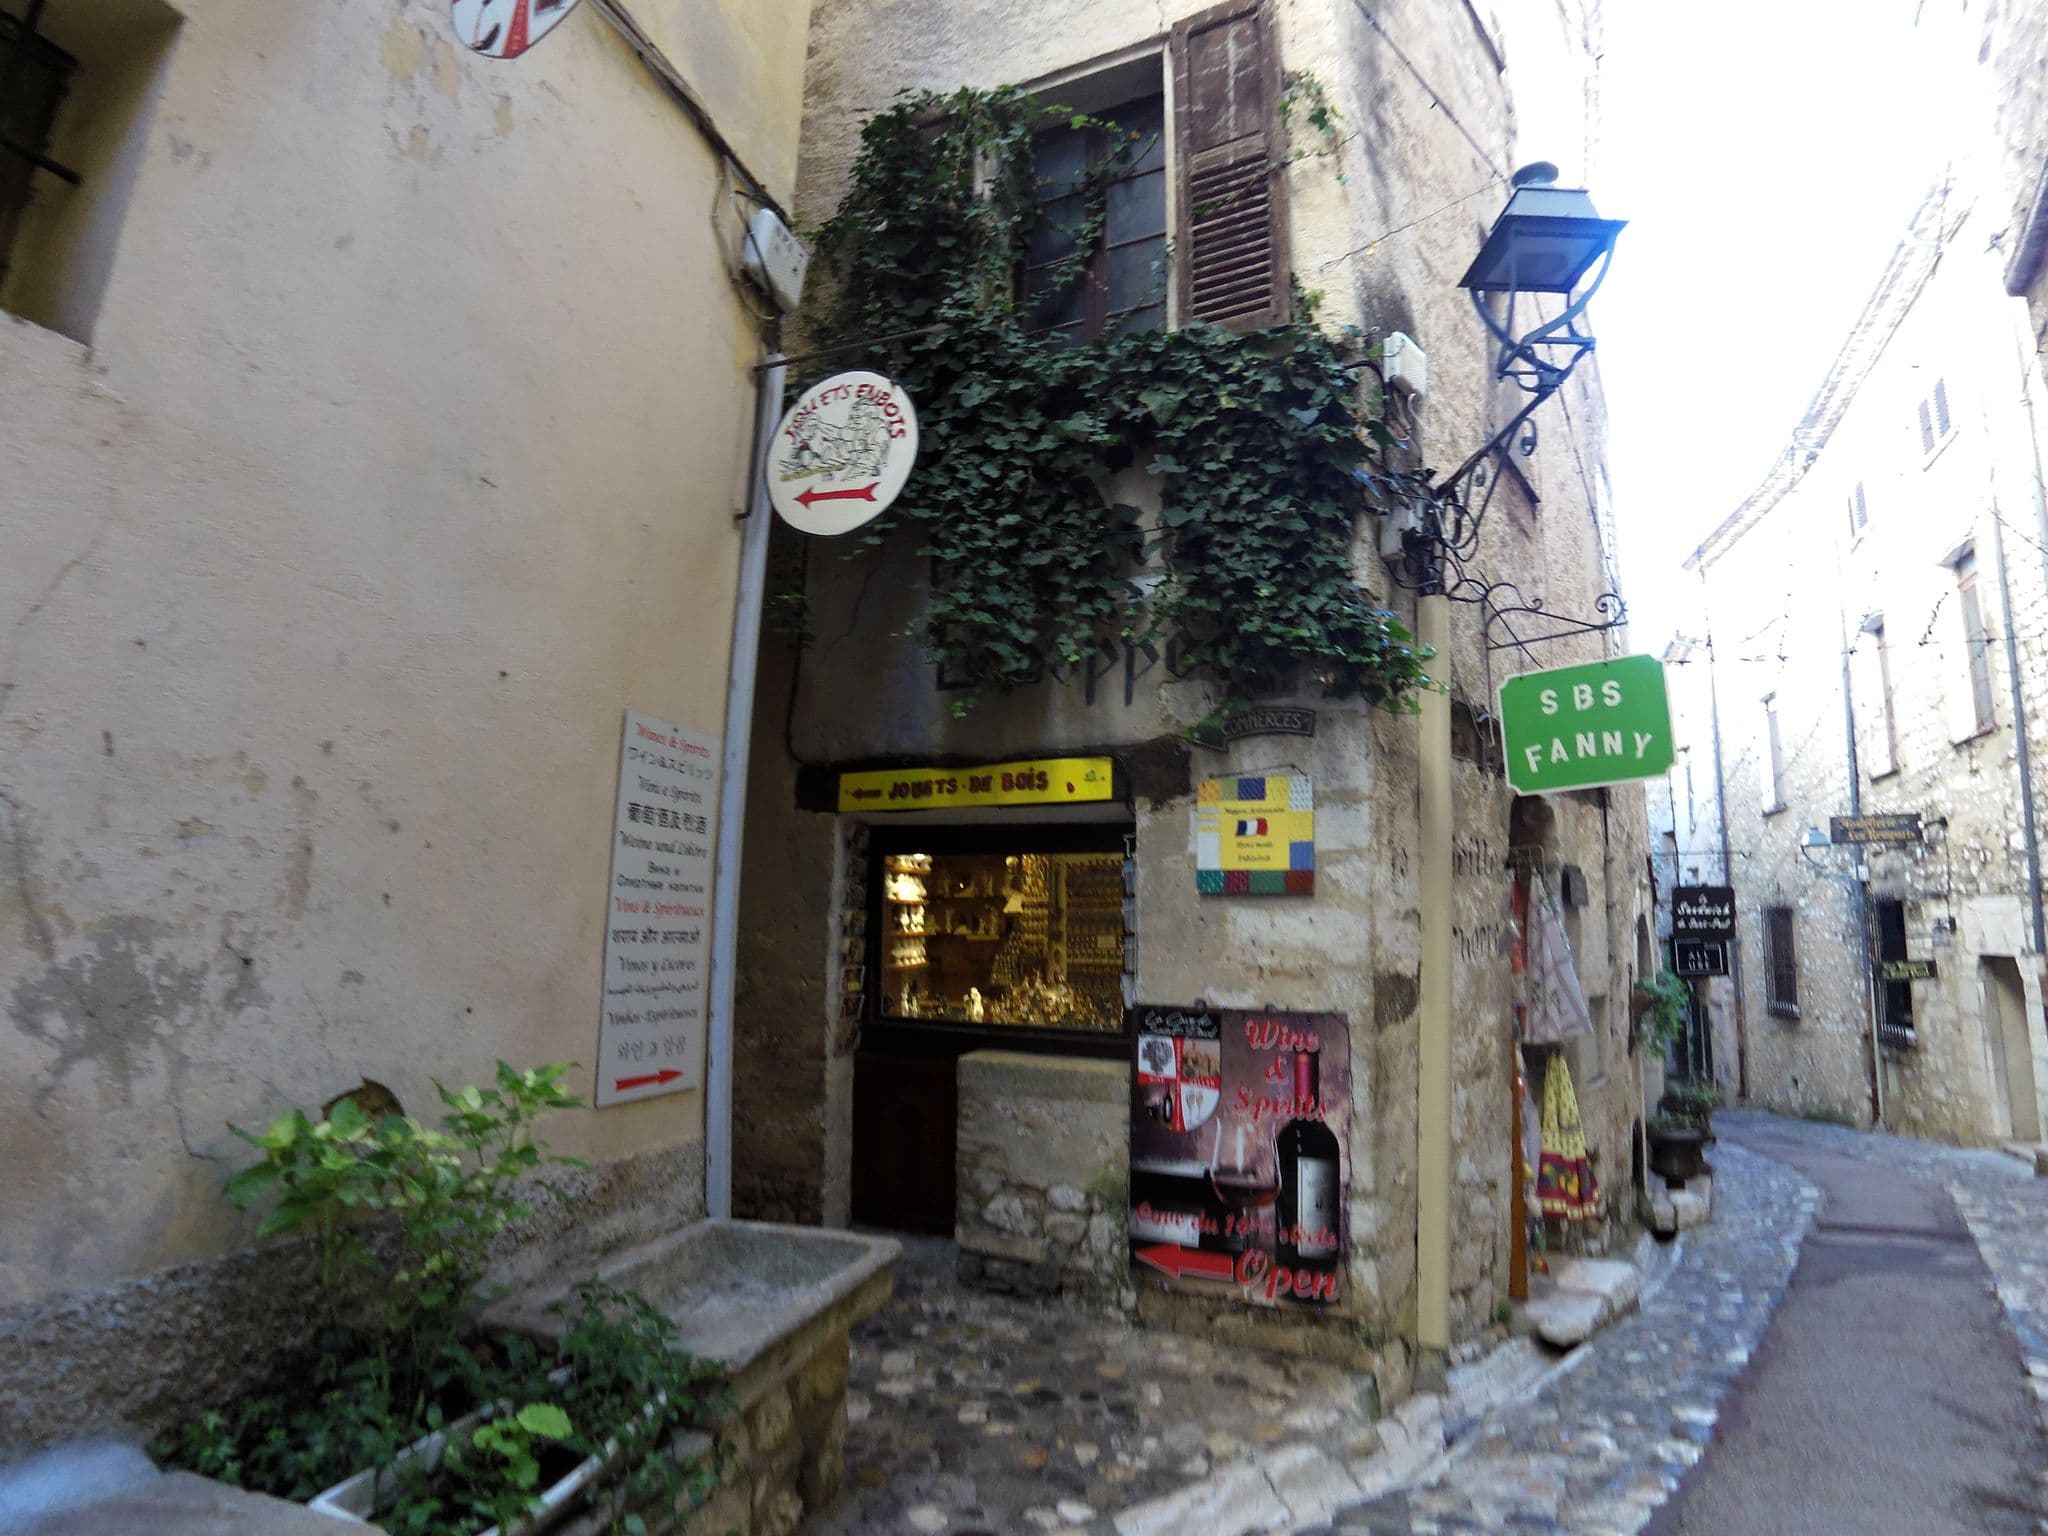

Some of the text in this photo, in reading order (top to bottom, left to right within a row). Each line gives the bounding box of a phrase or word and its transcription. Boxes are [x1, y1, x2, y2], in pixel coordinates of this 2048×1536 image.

[1540, 680, 1622, 715] SBS
[1525, 730, 1653, 773] FANNY
[1245, 1018, 1320, 1052] Wine
[1236, 1247, 1342, 1307] Open
